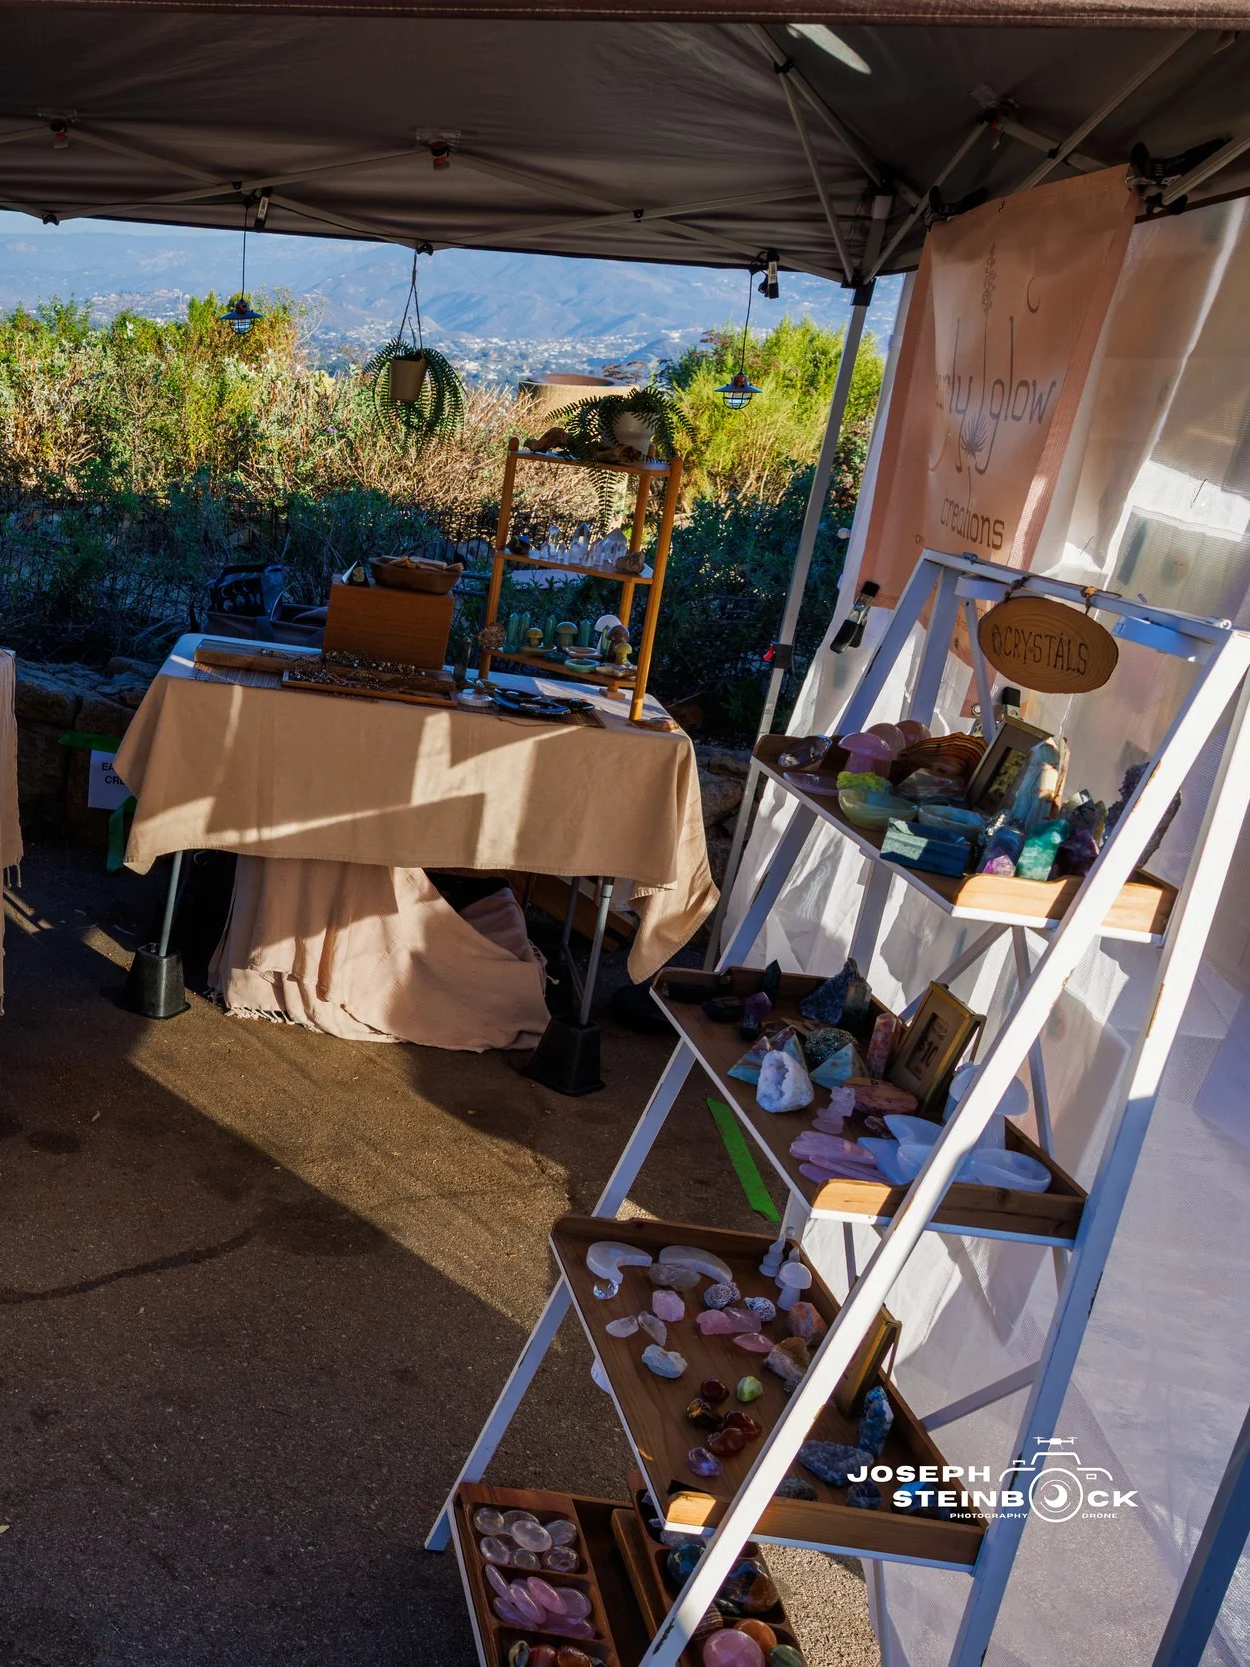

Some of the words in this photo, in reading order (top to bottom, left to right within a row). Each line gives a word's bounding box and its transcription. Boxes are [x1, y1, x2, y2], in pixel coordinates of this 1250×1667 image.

[975, 316, 1057, 475] glow
[940, 497, 1005, 550] creations
[1004, 625, 1088, 676] CRYSTALS
